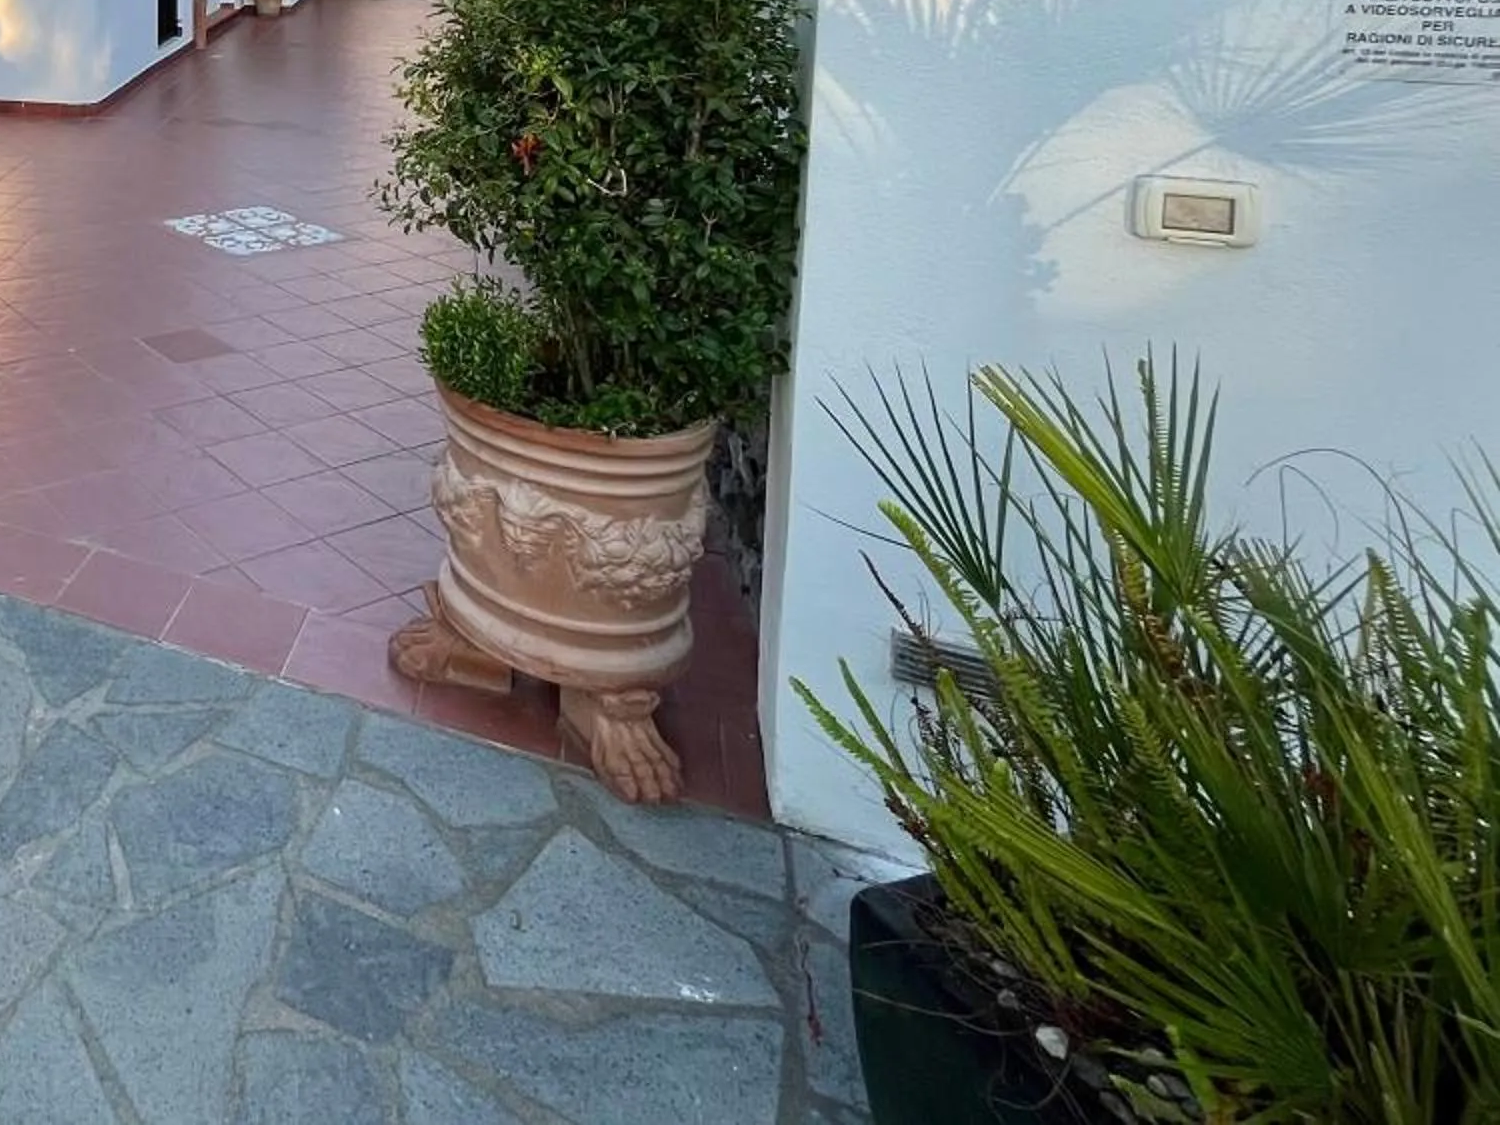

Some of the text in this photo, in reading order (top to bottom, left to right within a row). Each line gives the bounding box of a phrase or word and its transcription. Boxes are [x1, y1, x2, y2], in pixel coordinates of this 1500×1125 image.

[1345, 4, 1356, 14] A
[1421, 20, 1454, 32] PER
[1346, 32, 1412, 44] RAGIONI
[1417, 34, 1433, 46] DI
